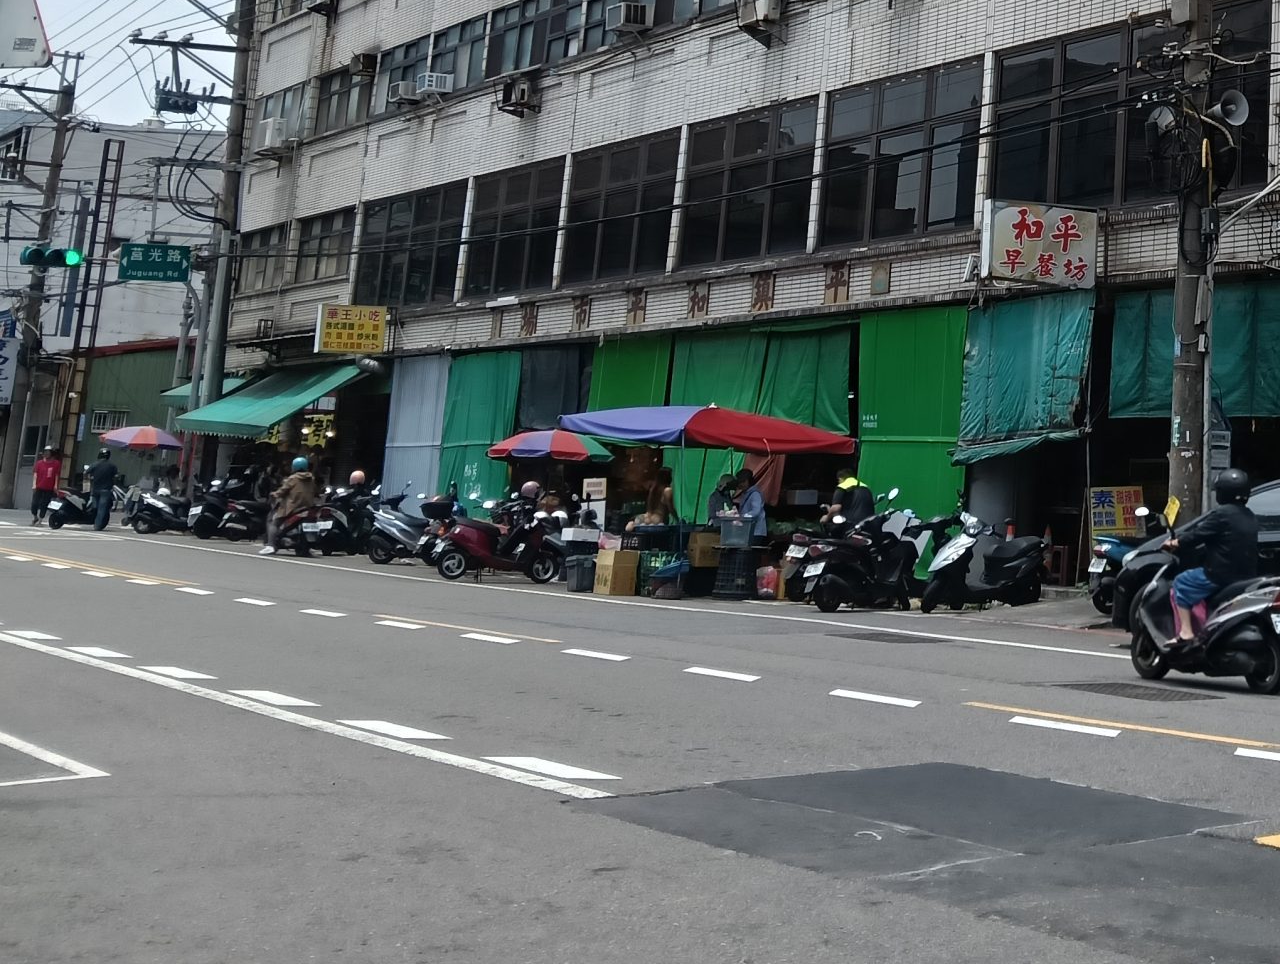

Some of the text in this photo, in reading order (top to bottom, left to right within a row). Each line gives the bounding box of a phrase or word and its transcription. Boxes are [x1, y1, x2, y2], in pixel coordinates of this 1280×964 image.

[1011, 208, 1083, 254] 和平
[130, 247, 182, 263] 莒光路
[998, 247, 1089, 282] 早餐坊
[127, 269, 164, 279] Juguang
[326, 307, 381, 322] 華王小吃
[1091, 489, 1116, 510] 素
